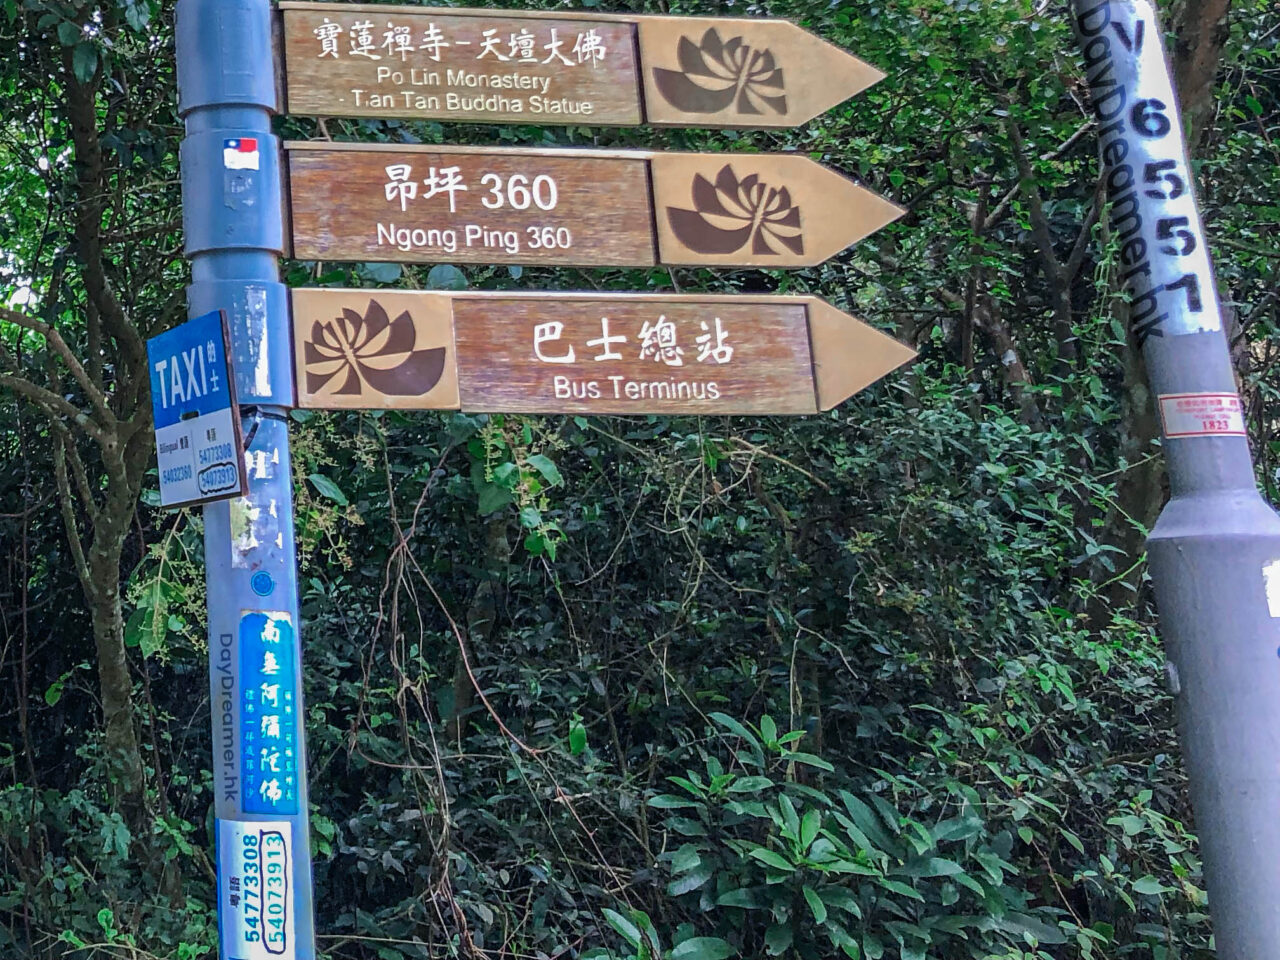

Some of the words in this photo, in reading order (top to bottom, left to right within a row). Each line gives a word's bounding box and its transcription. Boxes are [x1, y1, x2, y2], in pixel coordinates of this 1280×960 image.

[376, 66, 404, 86] Po
[410, 68, 440, 87] Lin
[447, 69, 551, 94] Monastery
[400, 90, 441, 110] Tan
[445, 92, 523, 114] Buddha
[528, 95, 594, 116] Statue
[383, 163, 468, 214] 昂坪
[480, 171, 558, 212] 360
[376, 223, 458, 255] Ngong
[465, 224, 520, 255] Ping
[527, 226, 572, 250] 360
[206, 339, 220, 393] 的士
[531, 314, 735, 367] 巴士總站
[155, 344, 208, 410] TAXI
[553, 376, 601, 401] Bus
[610, 376, 721, 401] Terminus
[1202, 420, 1229, 431] 1823
[243, 833, 261, 943] 54773308
[267, 834, 284, 944] 54073913
